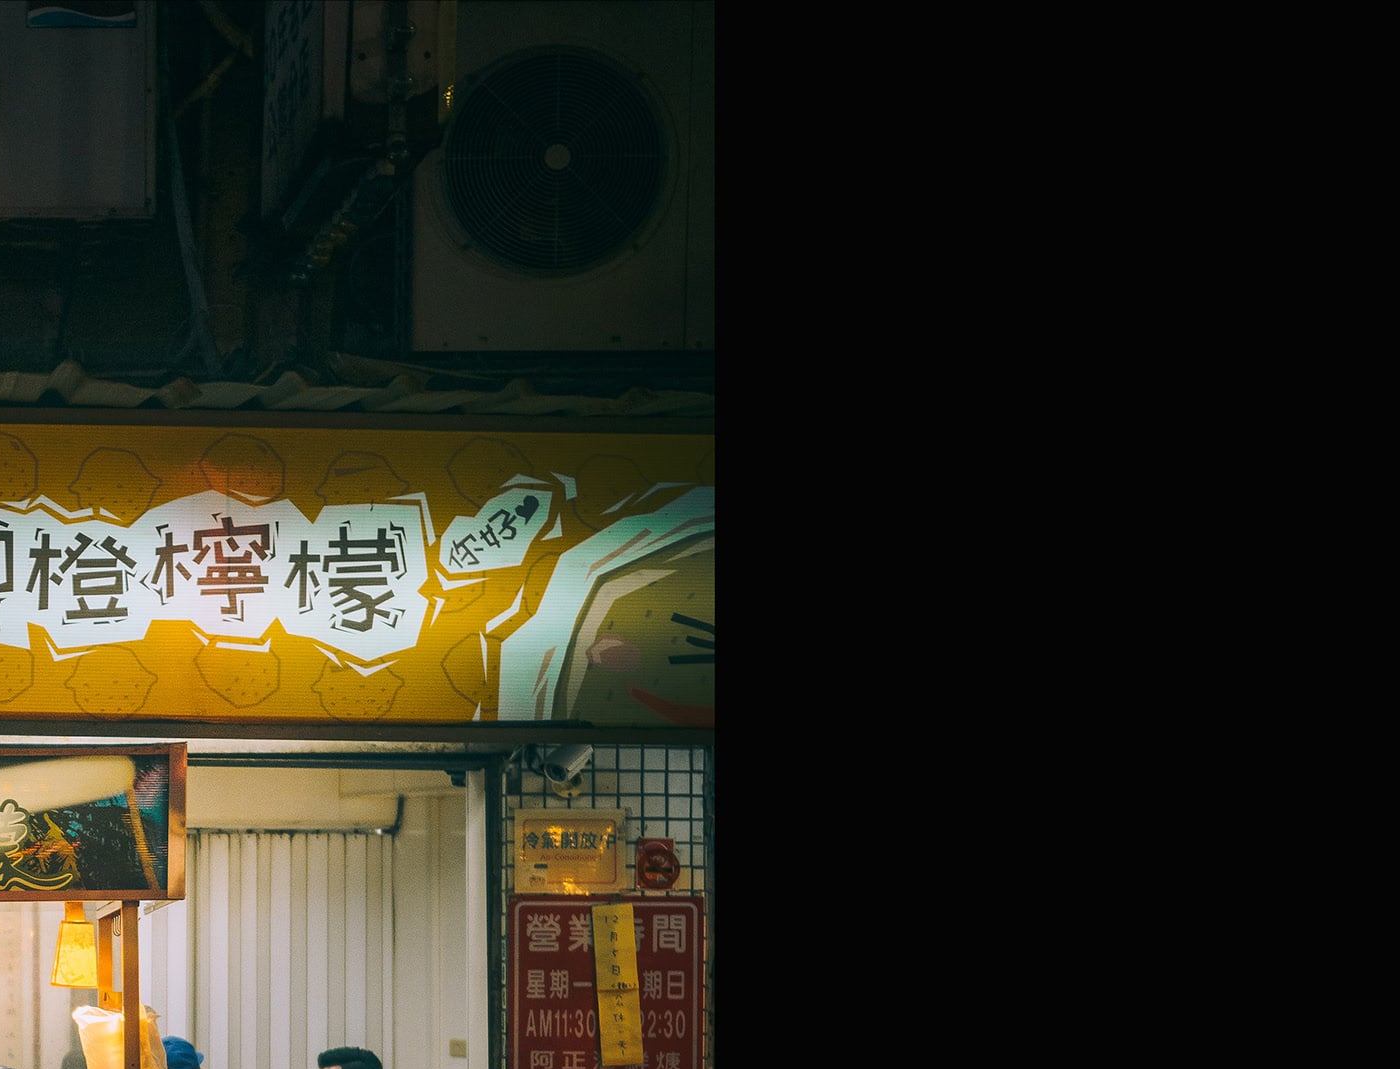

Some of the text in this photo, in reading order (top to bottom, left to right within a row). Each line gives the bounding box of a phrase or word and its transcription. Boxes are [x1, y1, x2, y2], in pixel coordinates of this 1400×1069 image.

[446, 510, 522, 571] 你好
[526, 912, 687, 953] 營業間
[526, 1009, 595, 1039] AM11:30
